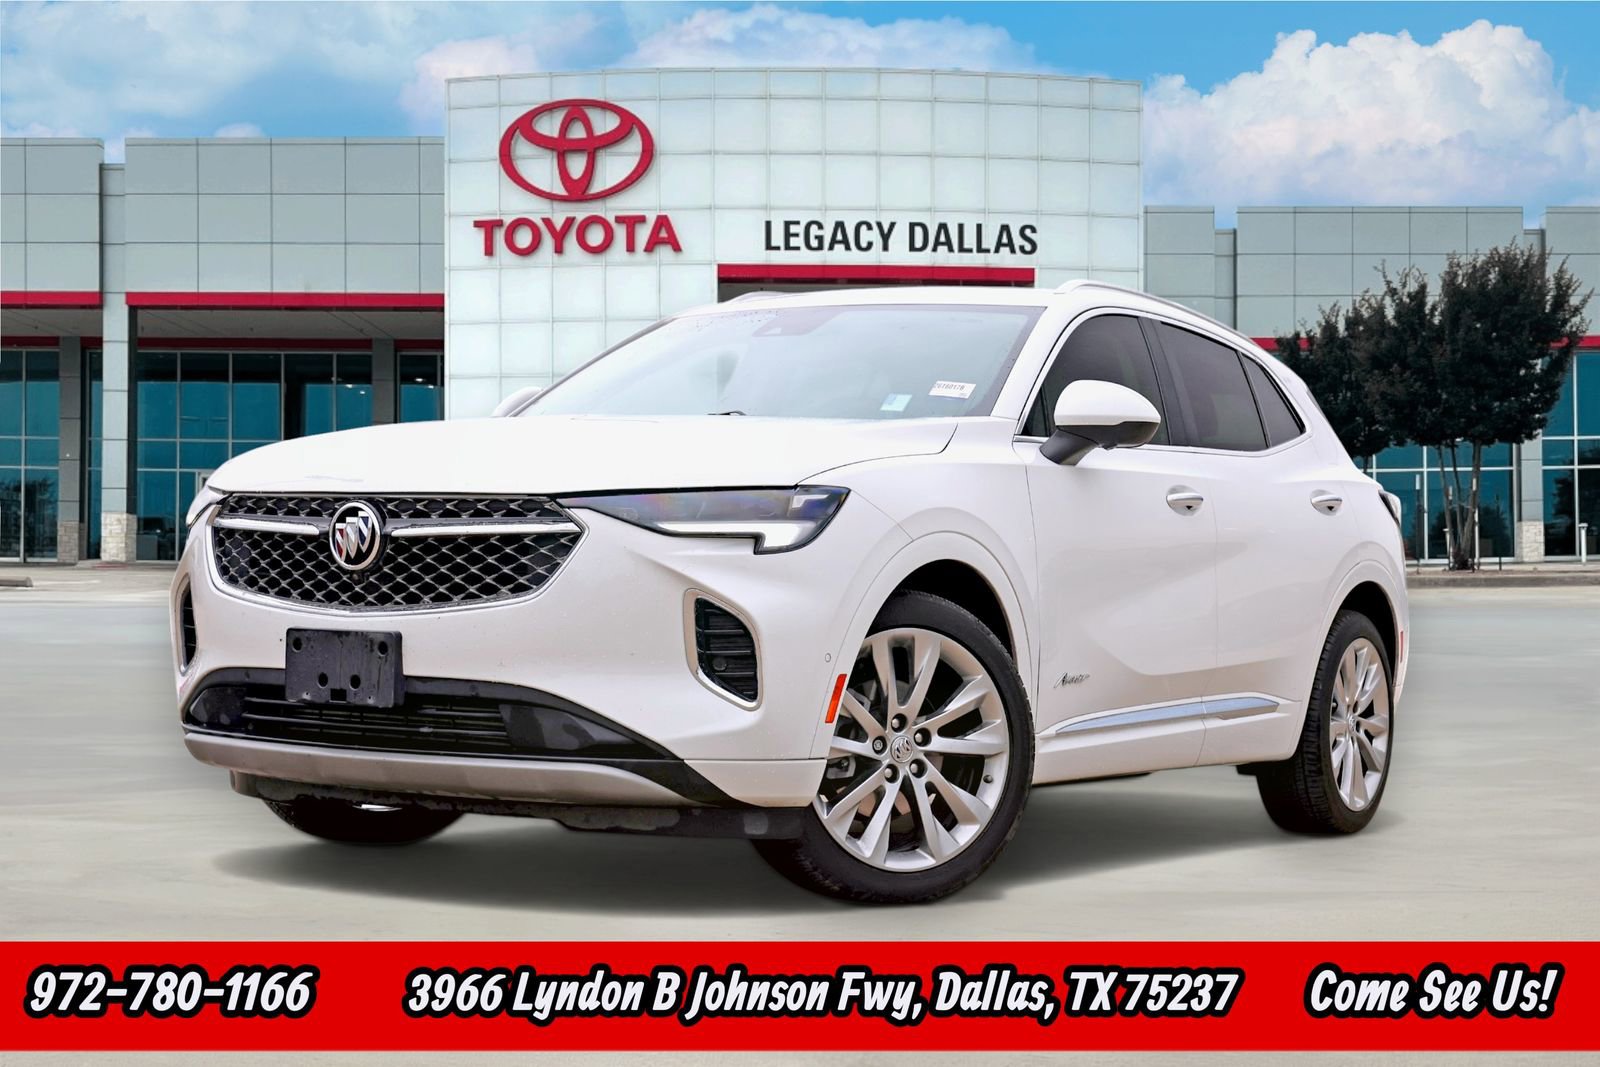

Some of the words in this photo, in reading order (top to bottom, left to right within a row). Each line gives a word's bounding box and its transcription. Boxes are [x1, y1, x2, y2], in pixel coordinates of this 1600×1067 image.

[474, 214, 682, 256] TOYOTA
[764, 220, 897, 252] LEGACY
[907, 221, 1038, 255] DALLAS
